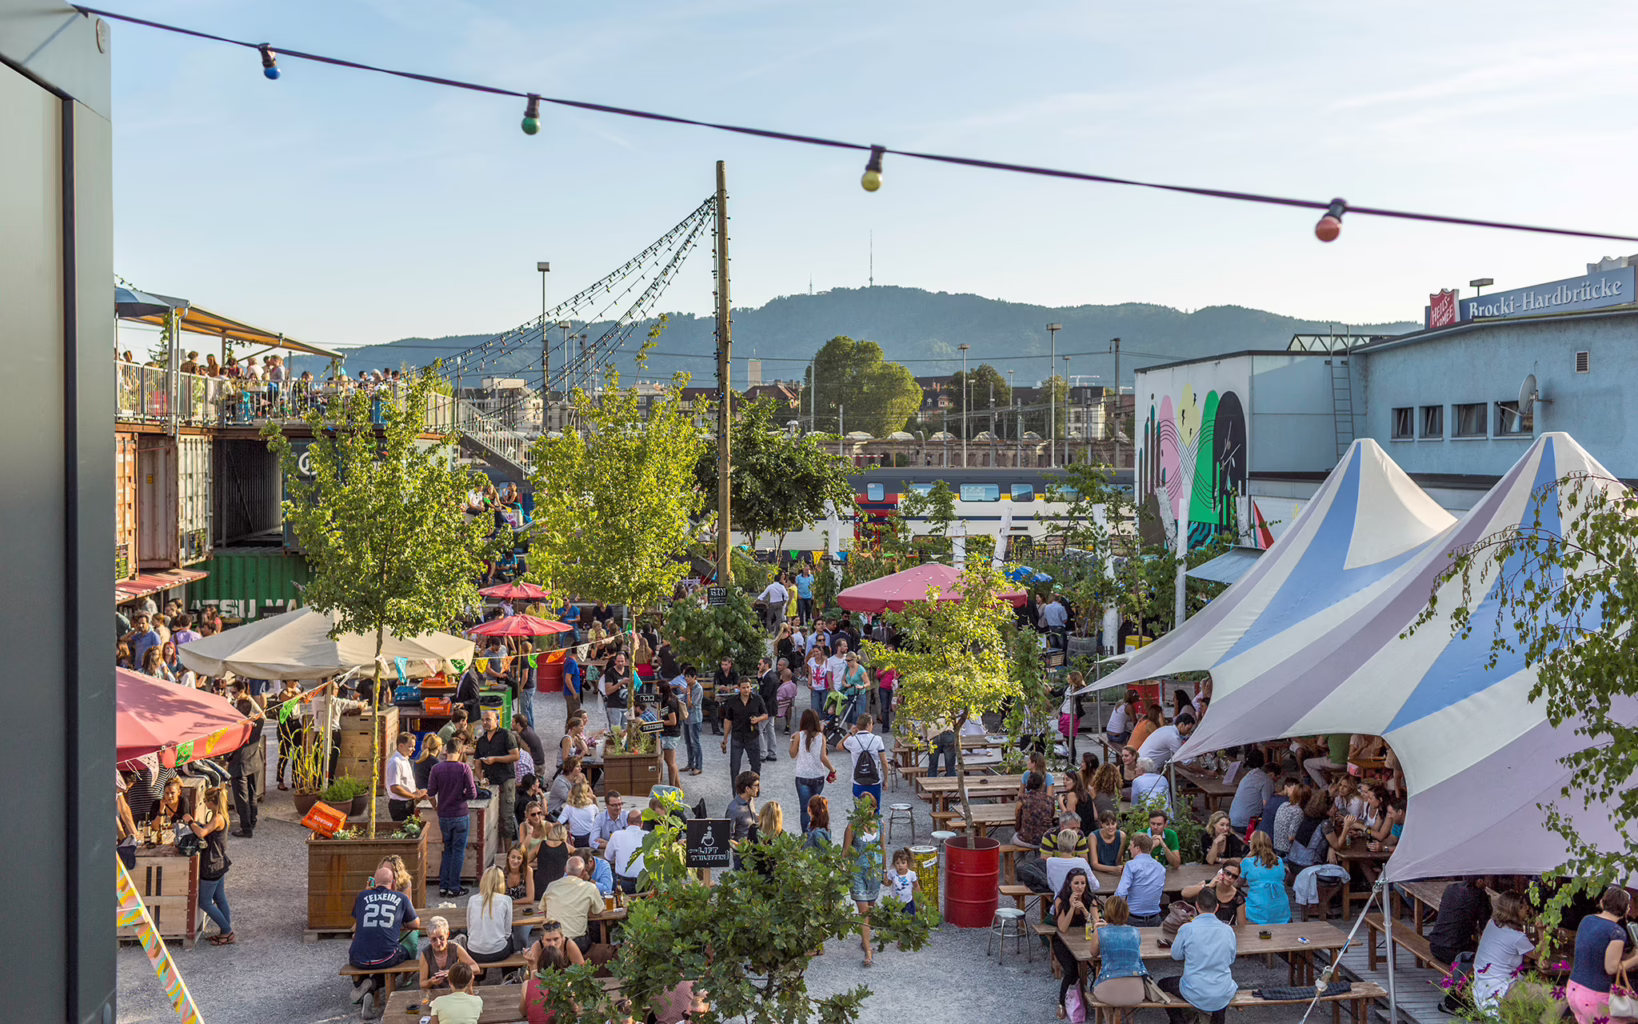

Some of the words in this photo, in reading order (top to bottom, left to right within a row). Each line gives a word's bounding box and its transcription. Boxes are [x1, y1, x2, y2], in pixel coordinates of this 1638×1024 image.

[1469, 277, 1623, 319] Brocki-Hardbrücke
[697, 846, 719, 855] LIFT
[363, 893, 402, 906] TEIXEIRA
[362, 903, 397, 928] 25
